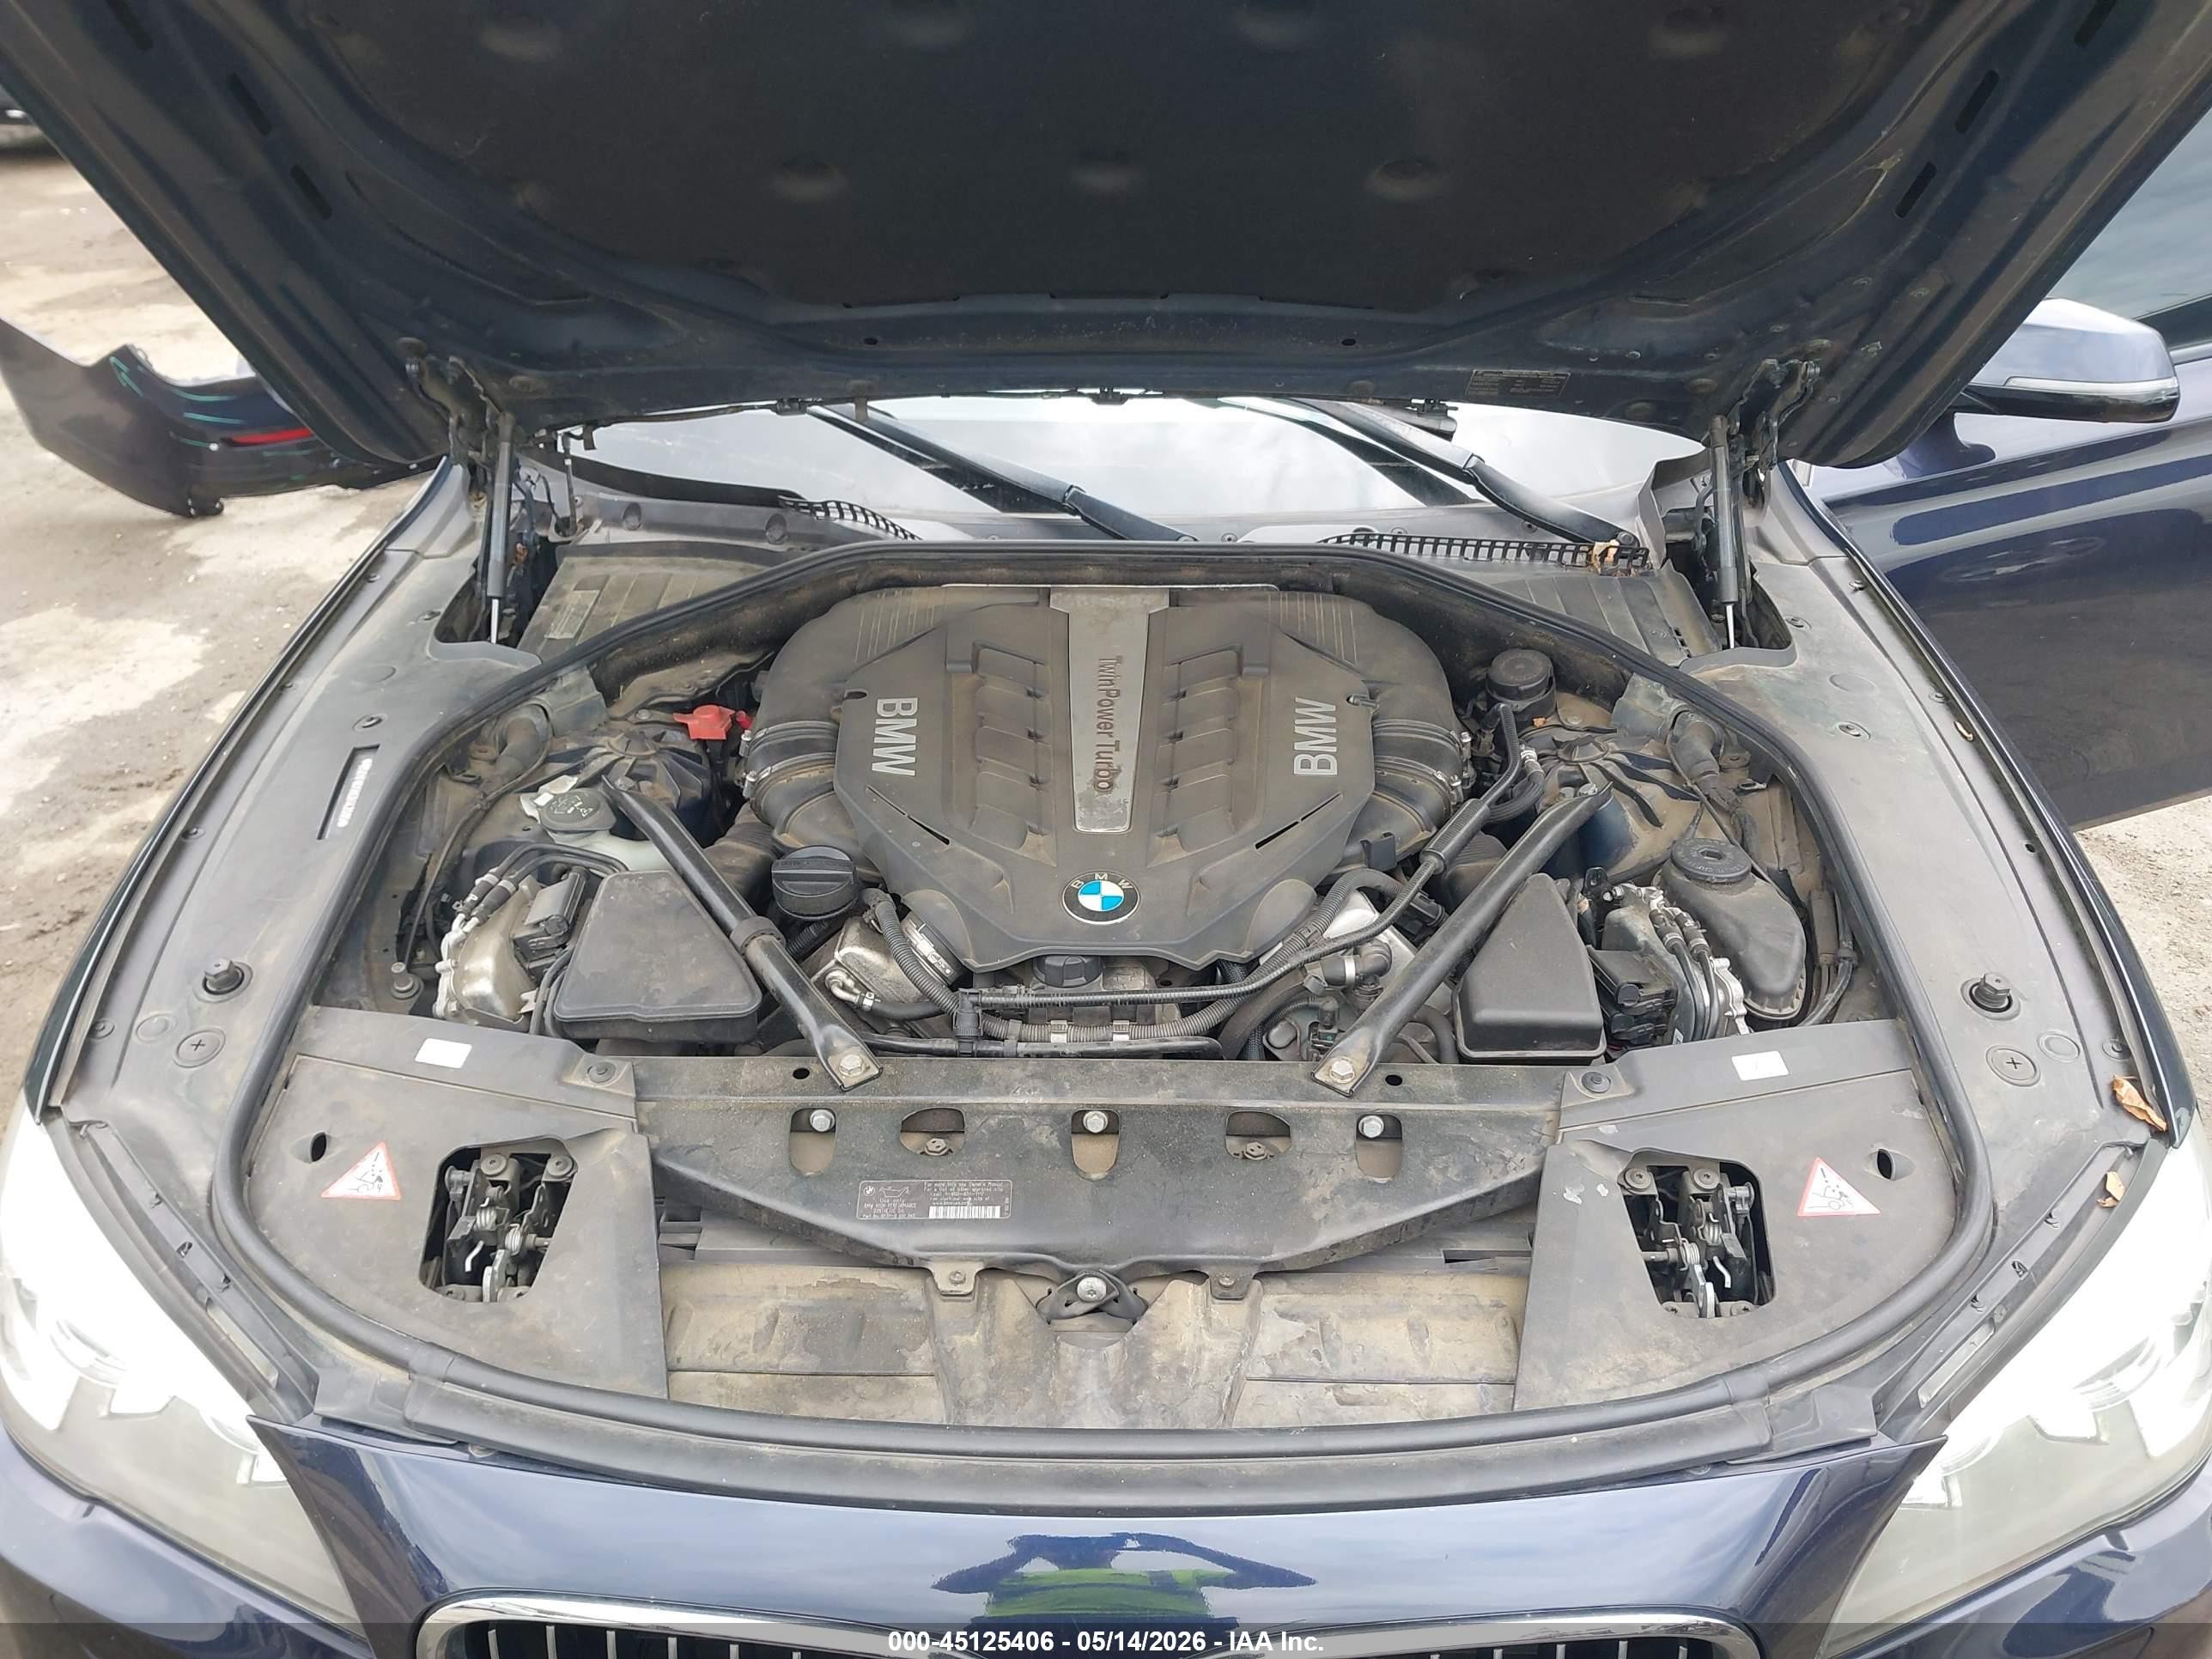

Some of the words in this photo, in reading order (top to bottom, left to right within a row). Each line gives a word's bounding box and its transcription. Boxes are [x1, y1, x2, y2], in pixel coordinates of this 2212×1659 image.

[1097, 655, 1123, 738] TwinPower
[1293, 696, 1337, 775] BMW
[872, 697, 918, 776] BMW
[1094, 740, 1122, 793] Turbo
[1070, 872, 1134, 890] BMW
